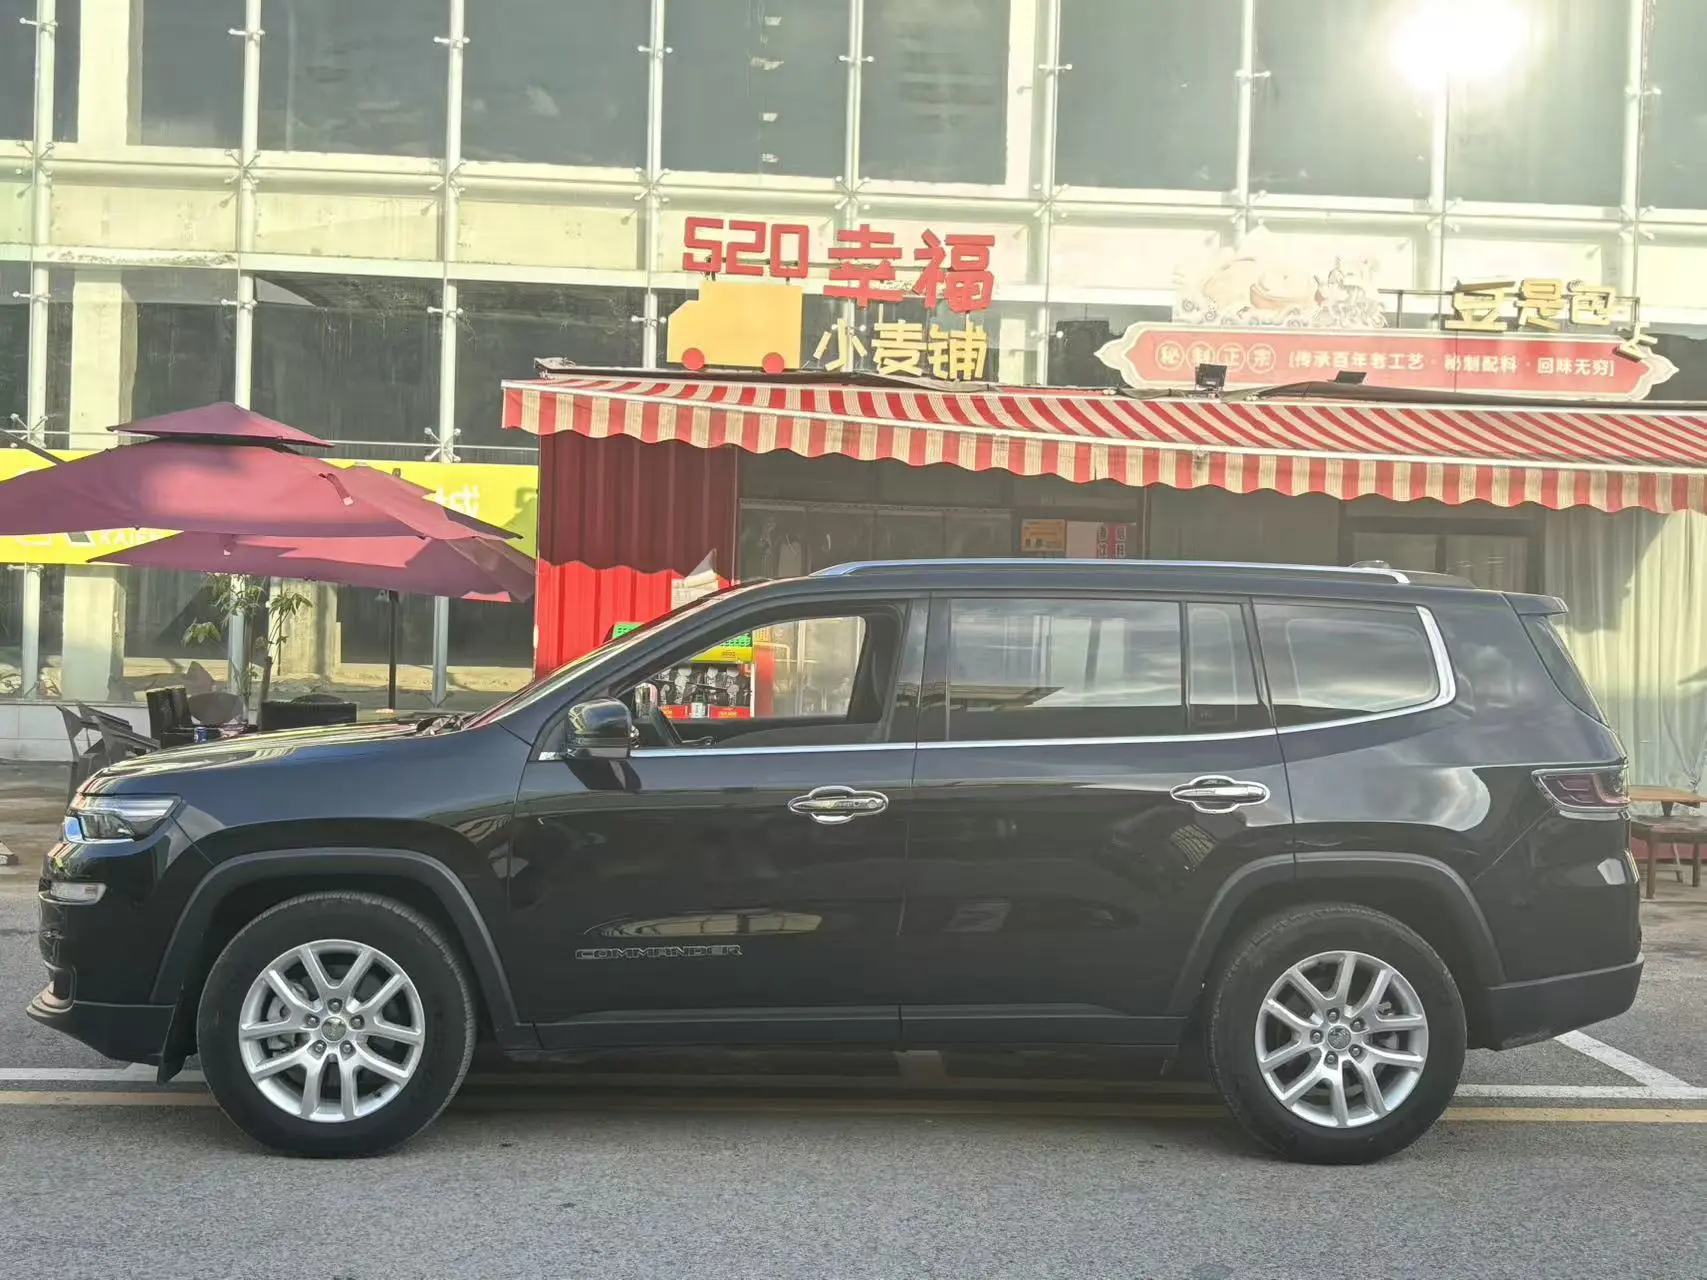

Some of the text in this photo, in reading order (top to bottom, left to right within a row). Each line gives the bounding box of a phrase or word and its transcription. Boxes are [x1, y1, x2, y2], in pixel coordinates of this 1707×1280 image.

[813, 318, 989, 382] 小麦铺
[575, 944, 743, 960] COMMANDER
